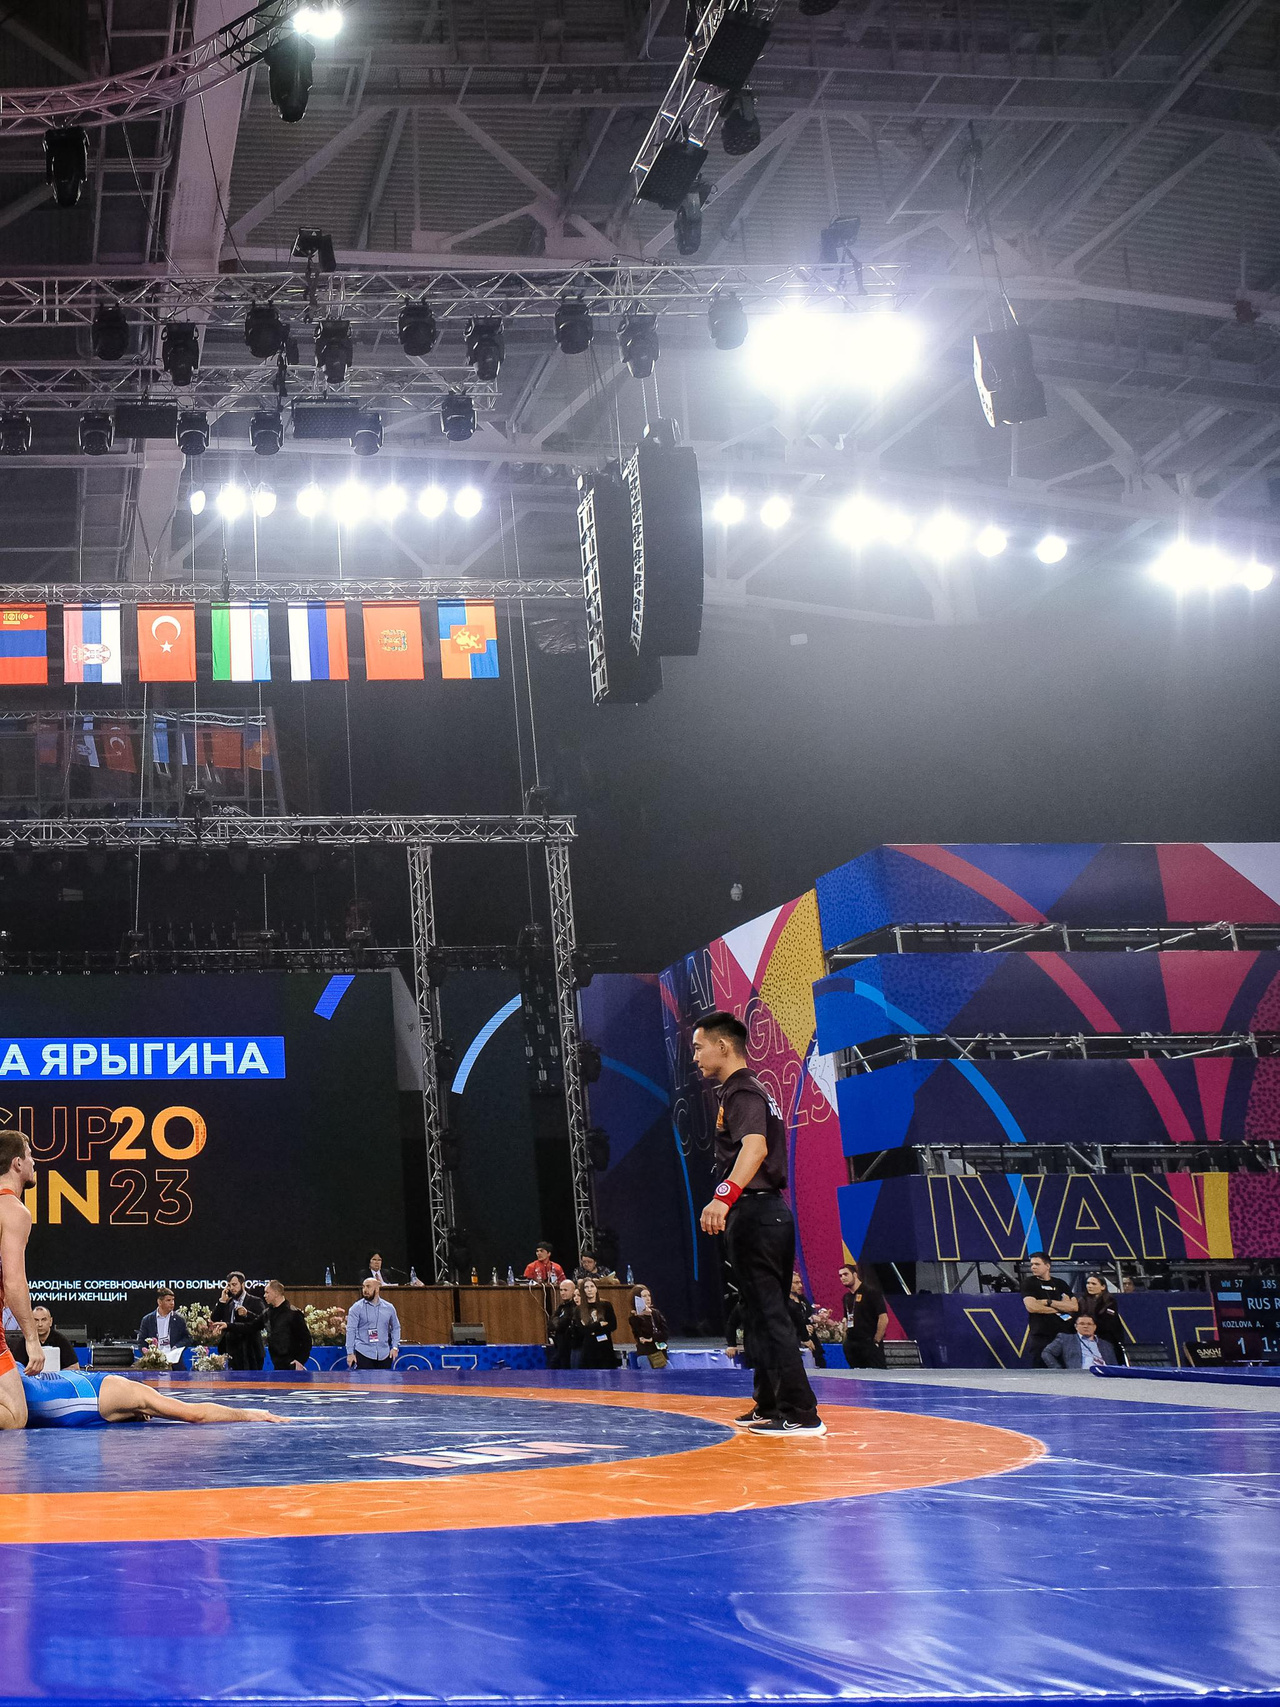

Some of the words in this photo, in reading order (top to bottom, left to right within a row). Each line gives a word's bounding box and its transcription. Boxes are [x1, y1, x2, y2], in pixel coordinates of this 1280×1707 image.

[39, 1042, 270, 1076] ЯРЫГИНА
[926, 1174, 1215, 1261] IVAN
[27, 1280, 82, 1291] НАРОДНЫЕ
[84, 1280, 166, 1290] СОРЕВНОВАНИЯ
[169, 1280, 185, 1290] ПО
[186, 1280, 229, 1290] ВОЛЬНО
[1234, 1279, 1244, 1288] 57
[1261, 1279, 1277, 1289] 185
[69, 1292, 77, 1302] И
[78, 1292, 128, 1303] ЖЕНЩИН
[1246, 1297, 1271, 1310] RUS
[1222, 1320, 1253, 1328] KOZLOVA
[1237, 1337, 1246, 1355] 1
